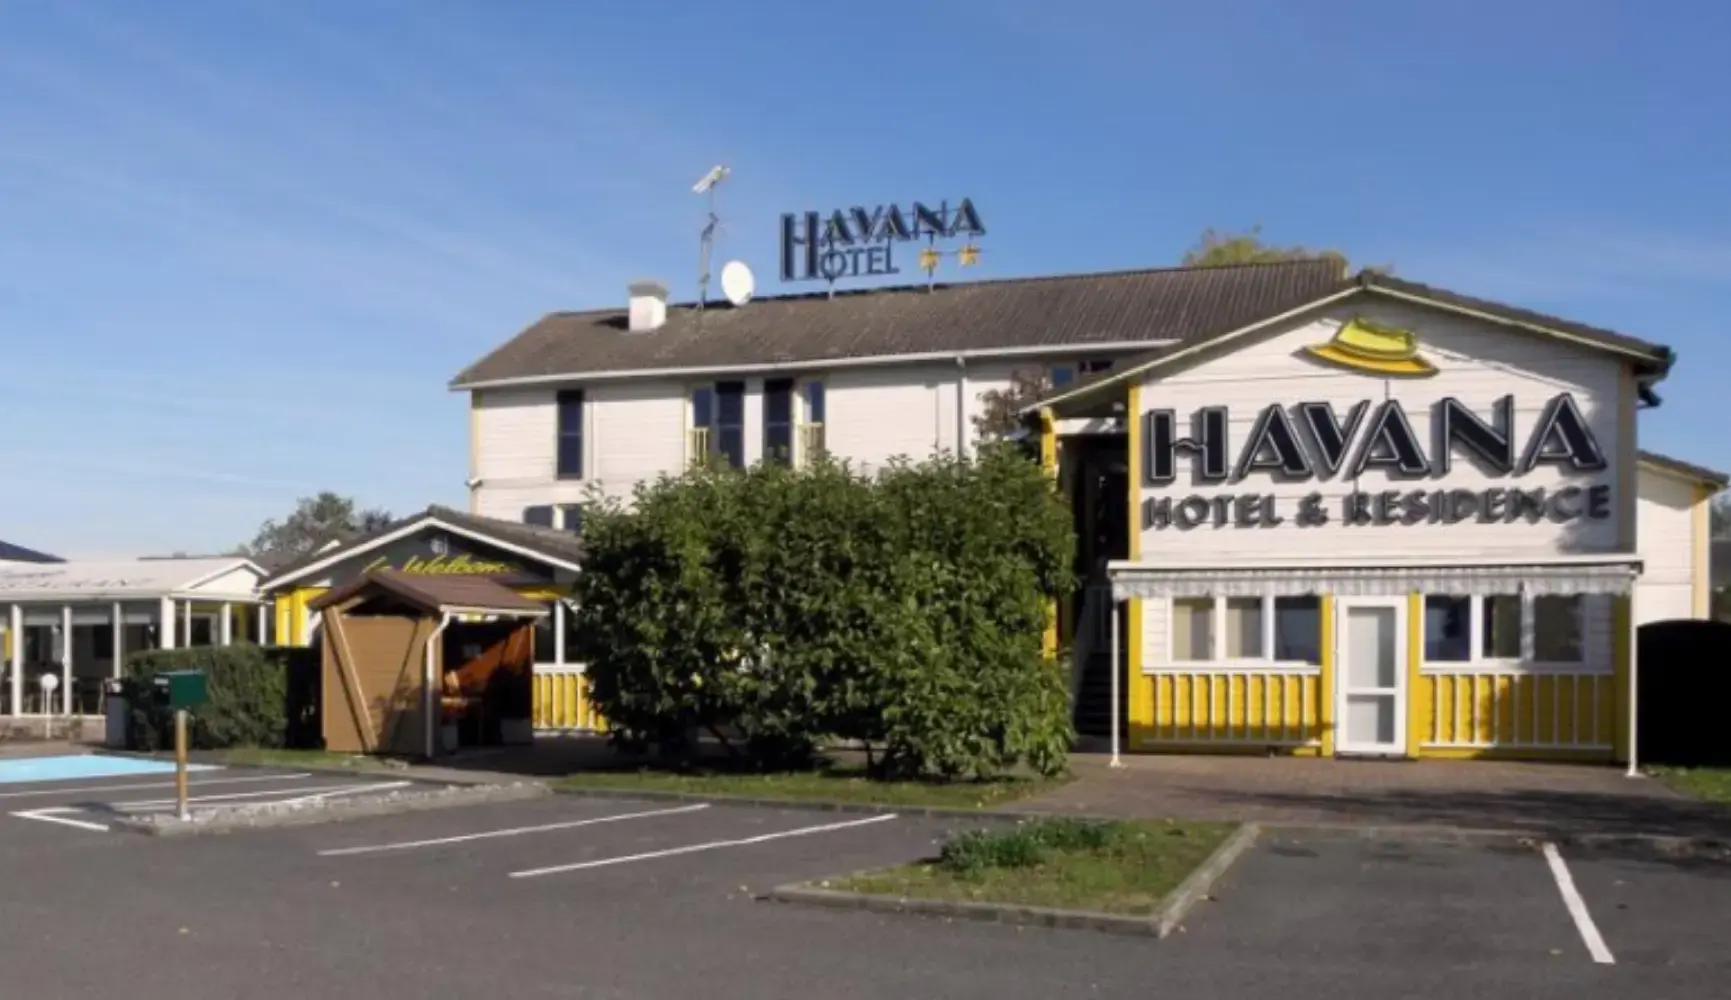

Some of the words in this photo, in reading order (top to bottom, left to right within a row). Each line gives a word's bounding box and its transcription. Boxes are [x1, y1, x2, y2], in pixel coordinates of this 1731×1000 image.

[780, 197, 986, 281] HAVANA
[1147, 392, 1607, 483] HAVANA
[1145, 493, 1284, 529] HOTEL
[1298, 492, 1330, 526] &
[1350, 485, 1611, 526] RESIDENCE
